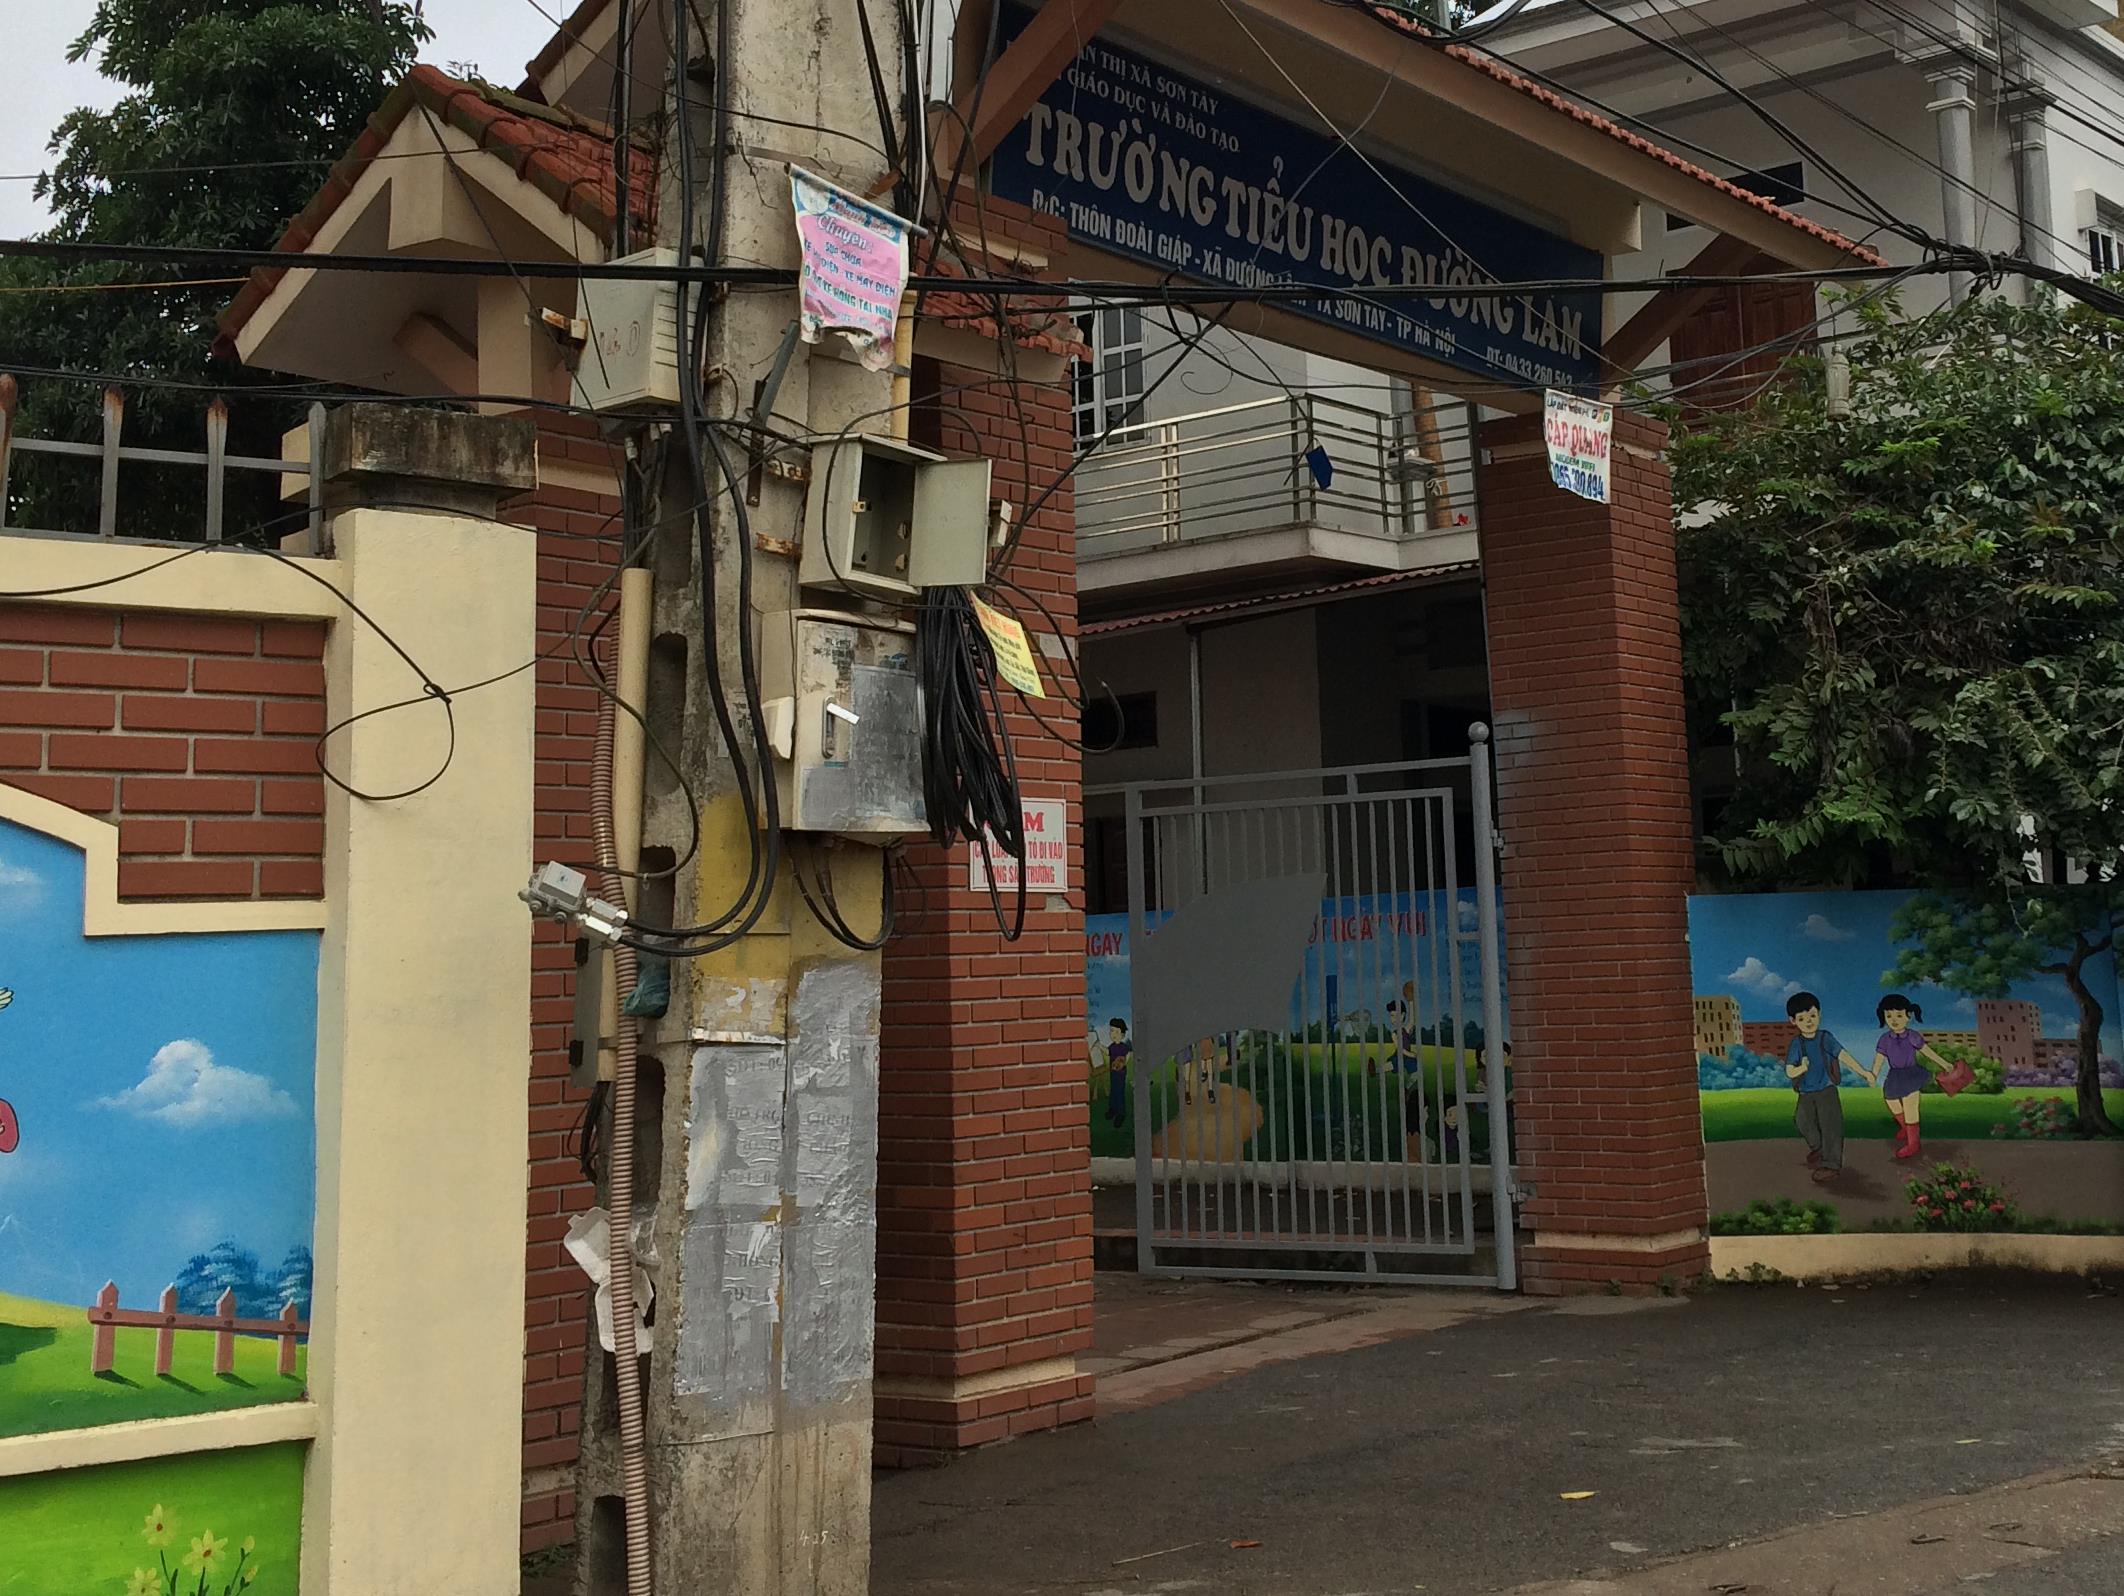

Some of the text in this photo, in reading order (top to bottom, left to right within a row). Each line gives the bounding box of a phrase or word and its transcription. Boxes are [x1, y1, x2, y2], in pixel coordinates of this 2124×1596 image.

[1067, 67, 1110, 99] GIÁO
[1114, 87, 1146, 114] DỤC
[1156, 75, 1187, 102] SƠN
[1023, 100, 1218, 227] TRƯỜNG
[1221, 155, 1314, 262] TIỂU
[1320, 214, 1392, 292] HỌC
[1070, 201, 1112, 240] THÔN
[1116, 218, 1153, 251] ĐOÀI
